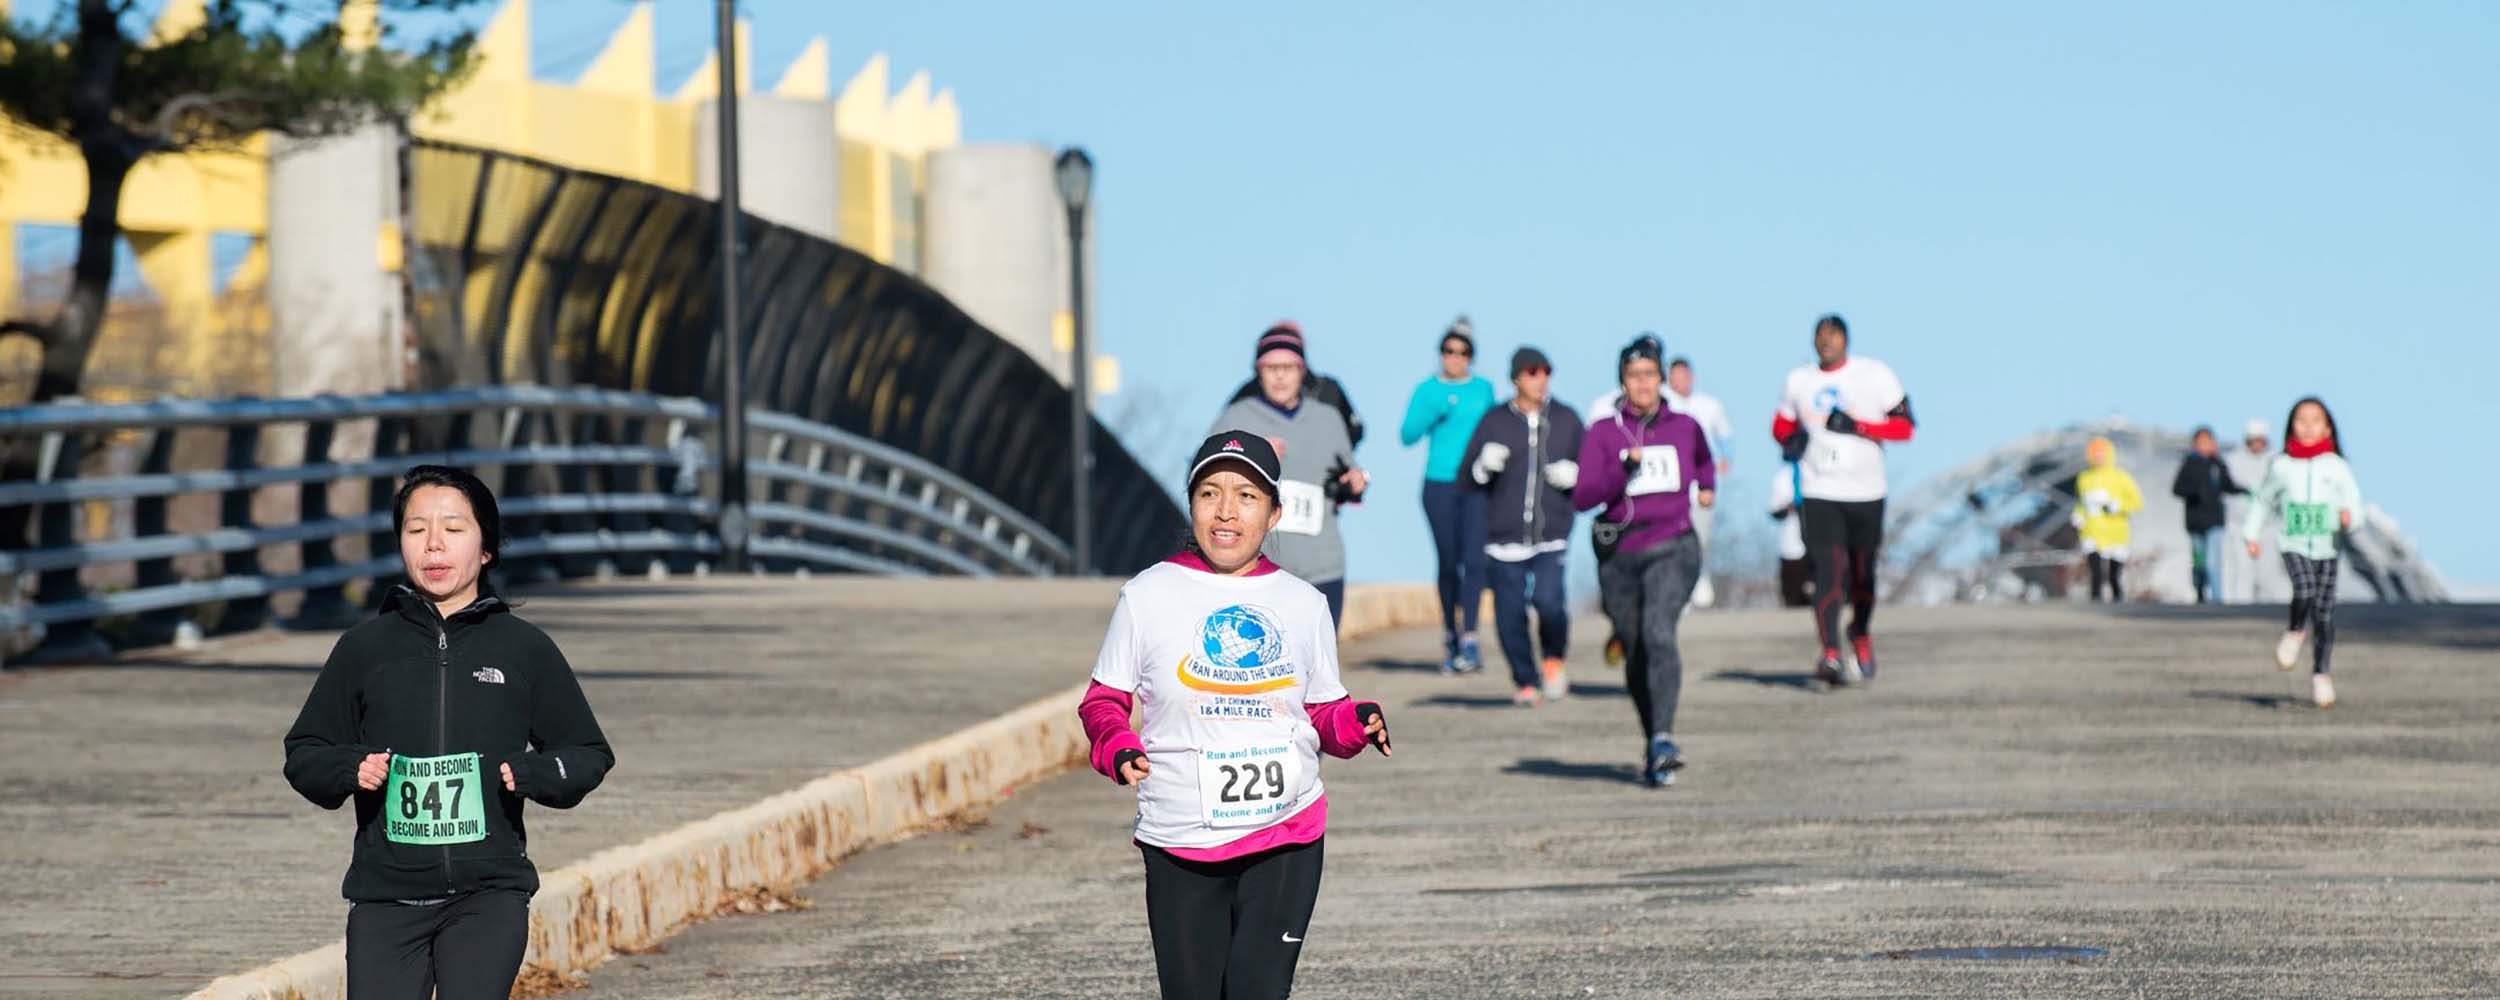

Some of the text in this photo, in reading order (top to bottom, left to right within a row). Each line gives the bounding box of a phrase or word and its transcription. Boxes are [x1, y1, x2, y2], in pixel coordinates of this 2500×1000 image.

[1192, 661, 1210, 677] RAN
[1213, 668, 1249, 682] AROUND
[1250, 668, 1267, 681] THE
[1200, 705, 1273, 718] 1&4 MILE RACE
[1206, 745, 1289, 760] Run and Become
[409, 762, 431, 777] AND
[434, 757, 474, 776] BECOME
[1219, 760, 1285, 803] 229
[400, 778, 465, 820] 847
[1212, 807, 1252, 819] Become
[1255, 804, 1273, 816] and
[391, 819, 479, 838] BECOME AND RUN
